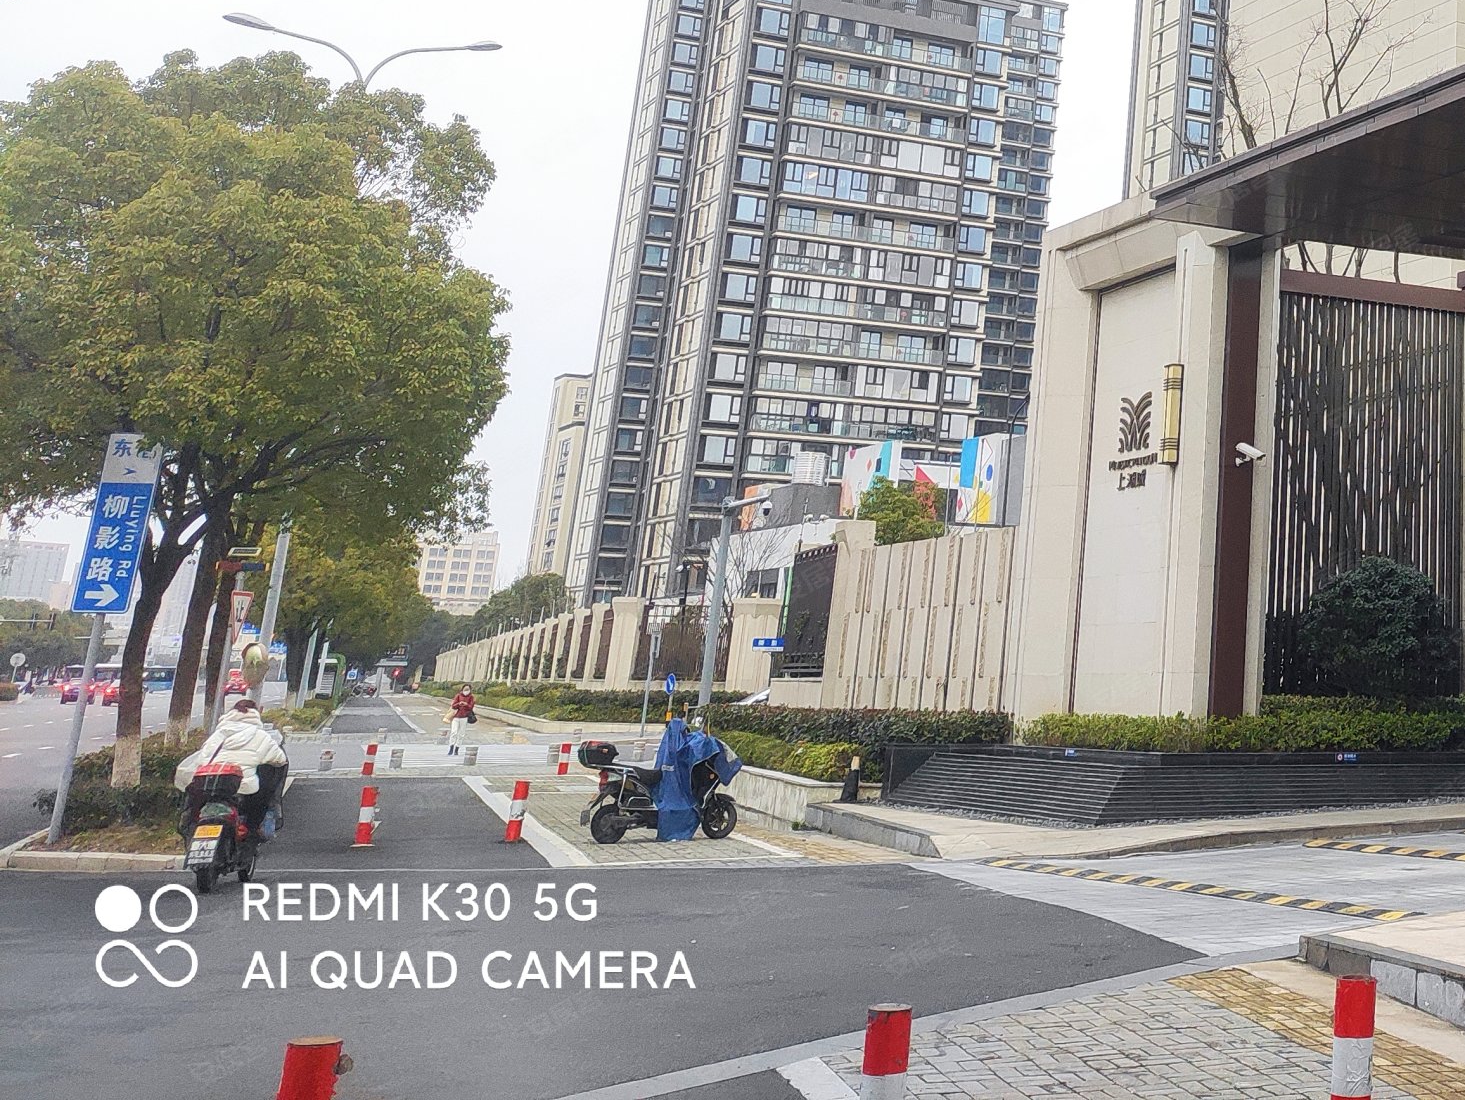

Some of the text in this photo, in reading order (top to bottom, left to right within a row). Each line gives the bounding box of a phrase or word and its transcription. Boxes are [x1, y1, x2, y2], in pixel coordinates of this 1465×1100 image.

[112, 438, 133, 458] 东
[86, 494, 130, 582] 柳影路
[115, 559, 132, 581] Rd.
